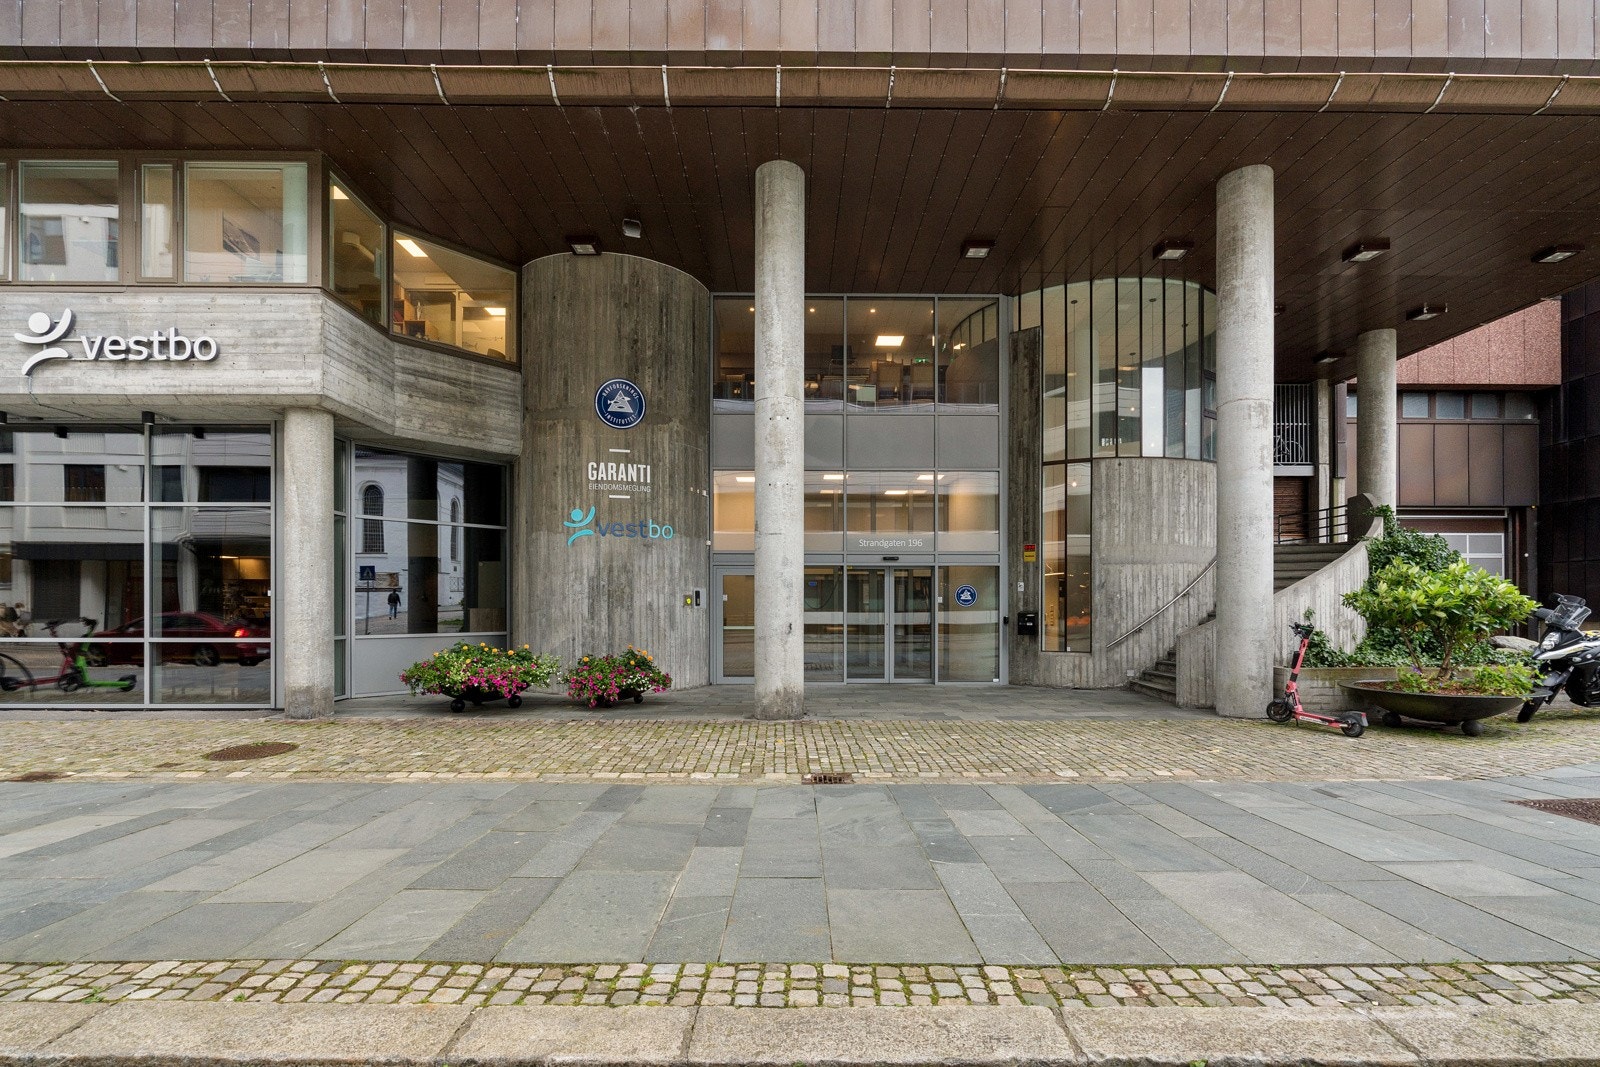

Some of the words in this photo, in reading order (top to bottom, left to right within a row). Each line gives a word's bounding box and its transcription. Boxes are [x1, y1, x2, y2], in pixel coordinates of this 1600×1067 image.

[80, 327, 219, 361] vestbo
[588, 461, 651, 483] GARANTI
[588, 483, 652, 493] EIENDOMSMEGLING
[597, 518, 674, 539] vestbo
[859, 539, 906, 549] Strandgaten
[908, 539, 923, 547] 196
